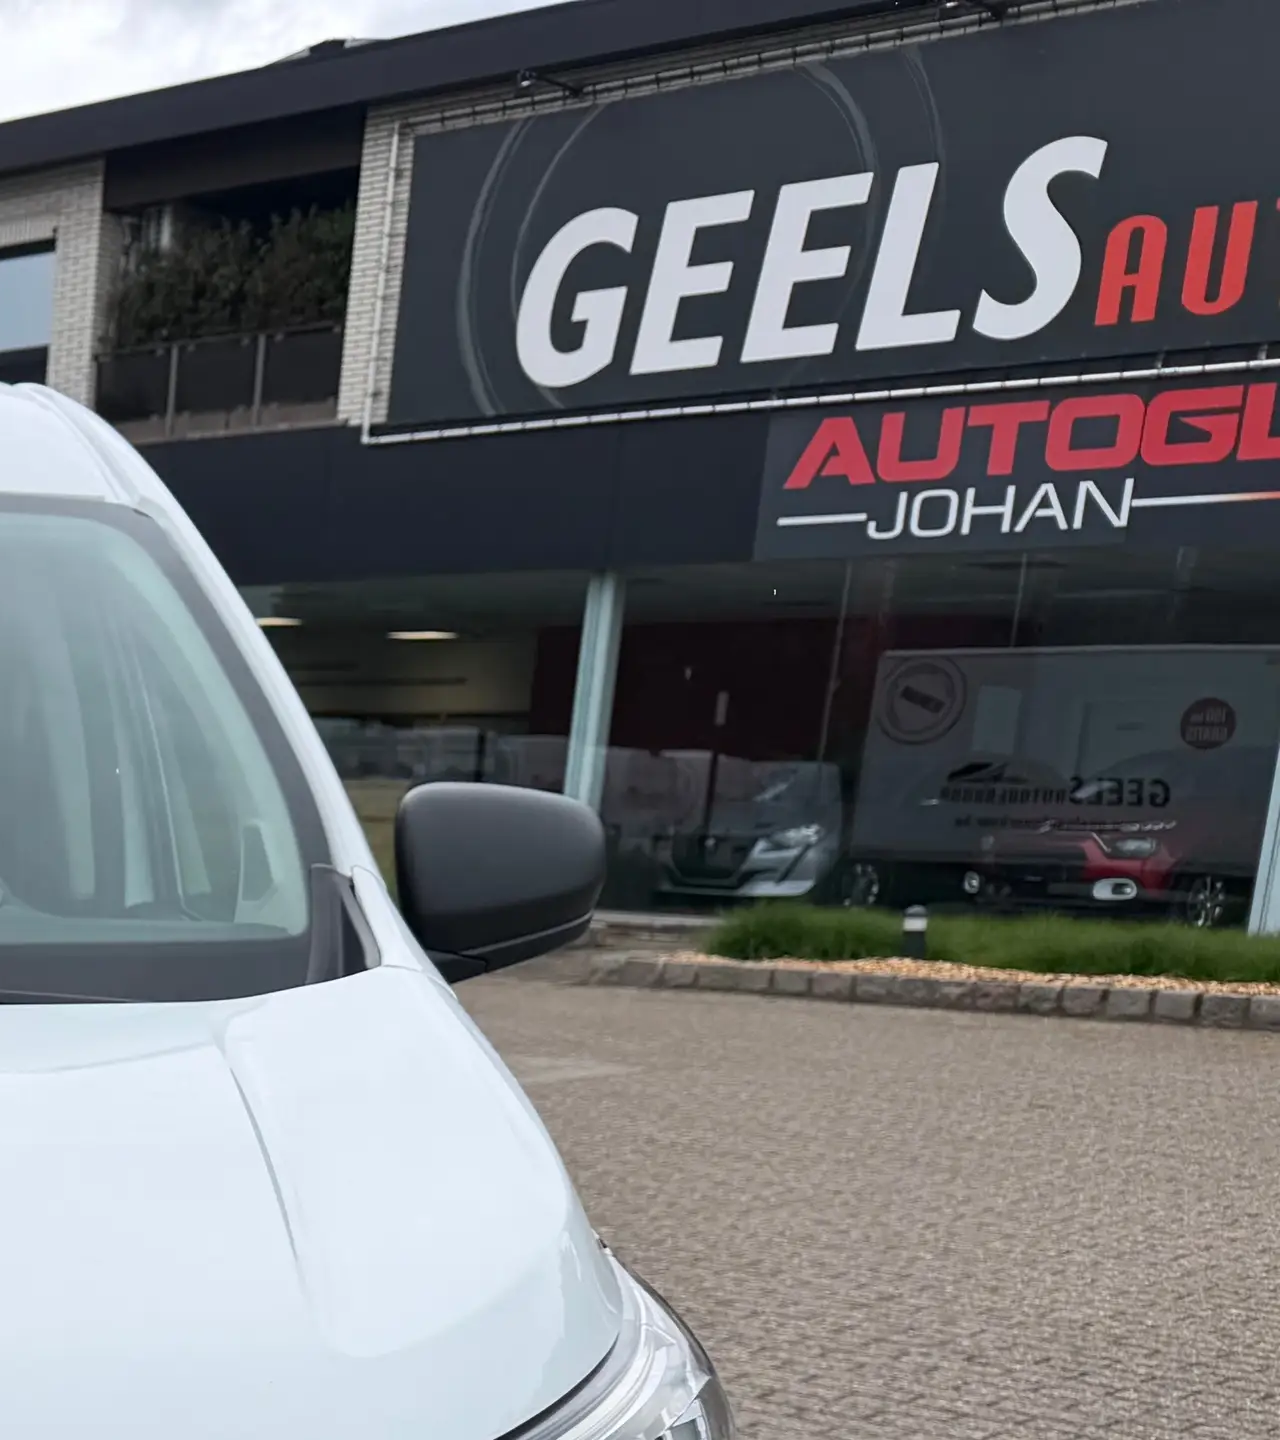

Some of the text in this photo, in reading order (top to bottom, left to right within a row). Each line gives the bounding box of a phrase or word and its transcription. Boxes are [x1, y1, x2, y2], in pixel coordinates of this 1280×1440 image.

[516, 136, 1280, 388] GEELS AU
[867, 478, 1135, 540] JOHAN
